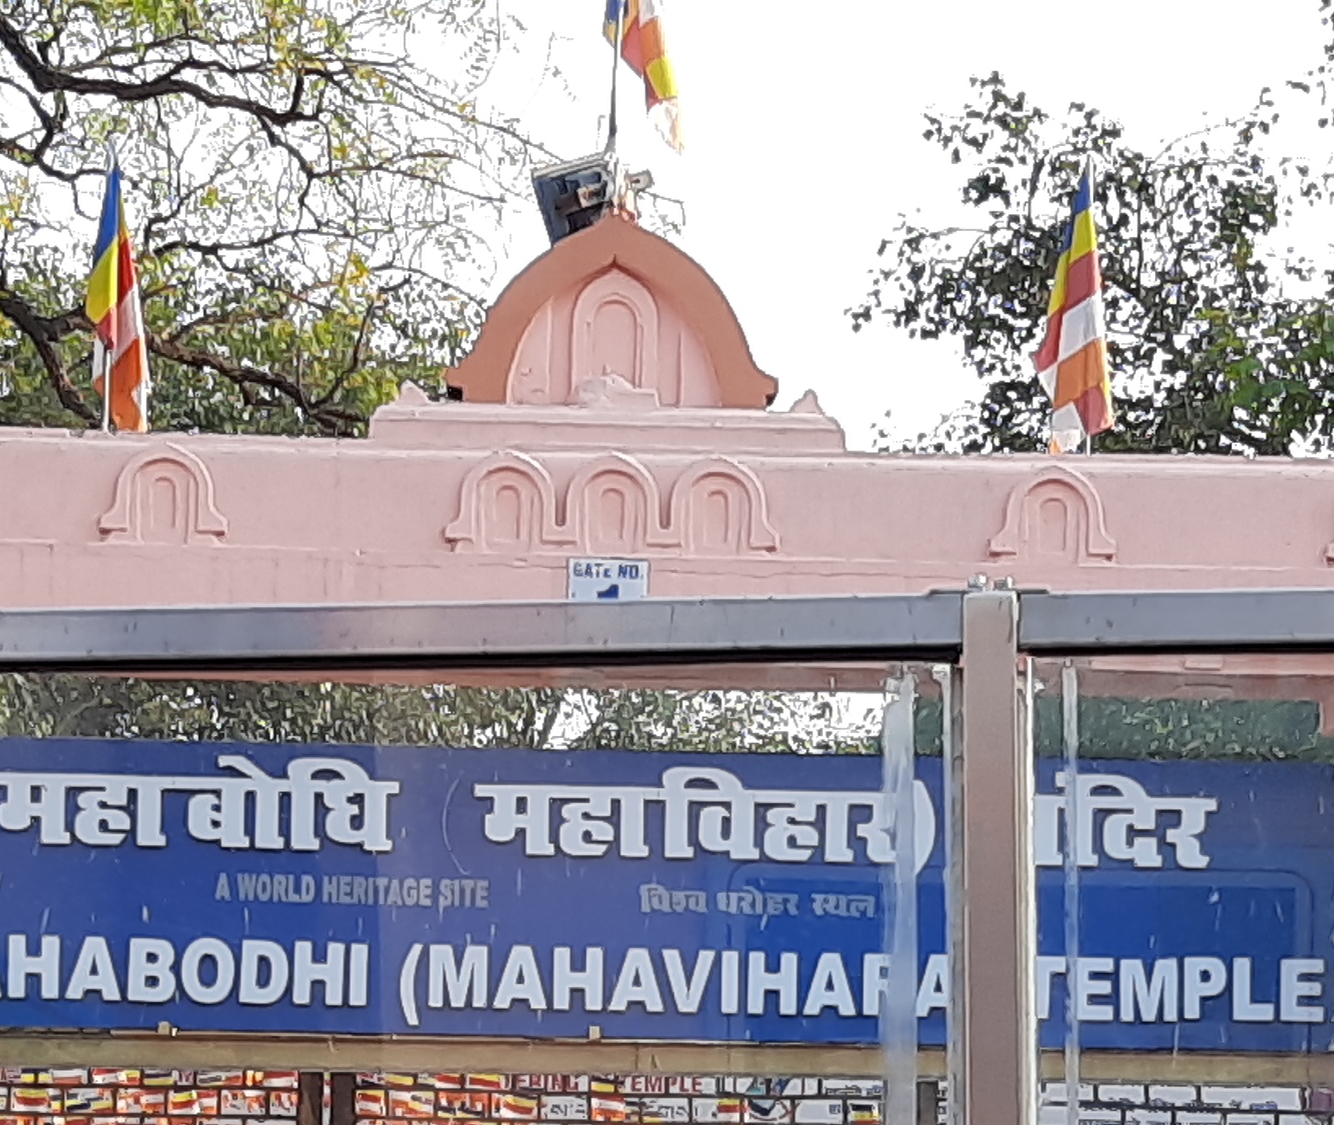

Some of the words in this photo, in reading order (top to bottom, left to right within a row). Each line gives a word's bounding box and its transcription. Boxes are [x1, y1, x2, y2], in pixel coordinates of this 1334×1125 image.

[216, 873, 230, 901] A
[237, 873, 315, 902] WORLD
[322, 875, 433, 907] HERITAGE
[438, 879, 490, 908] SITE
[811, 892, 876, 918] स्थल
[1034, 955, 1326, 1023] TEMPLE
